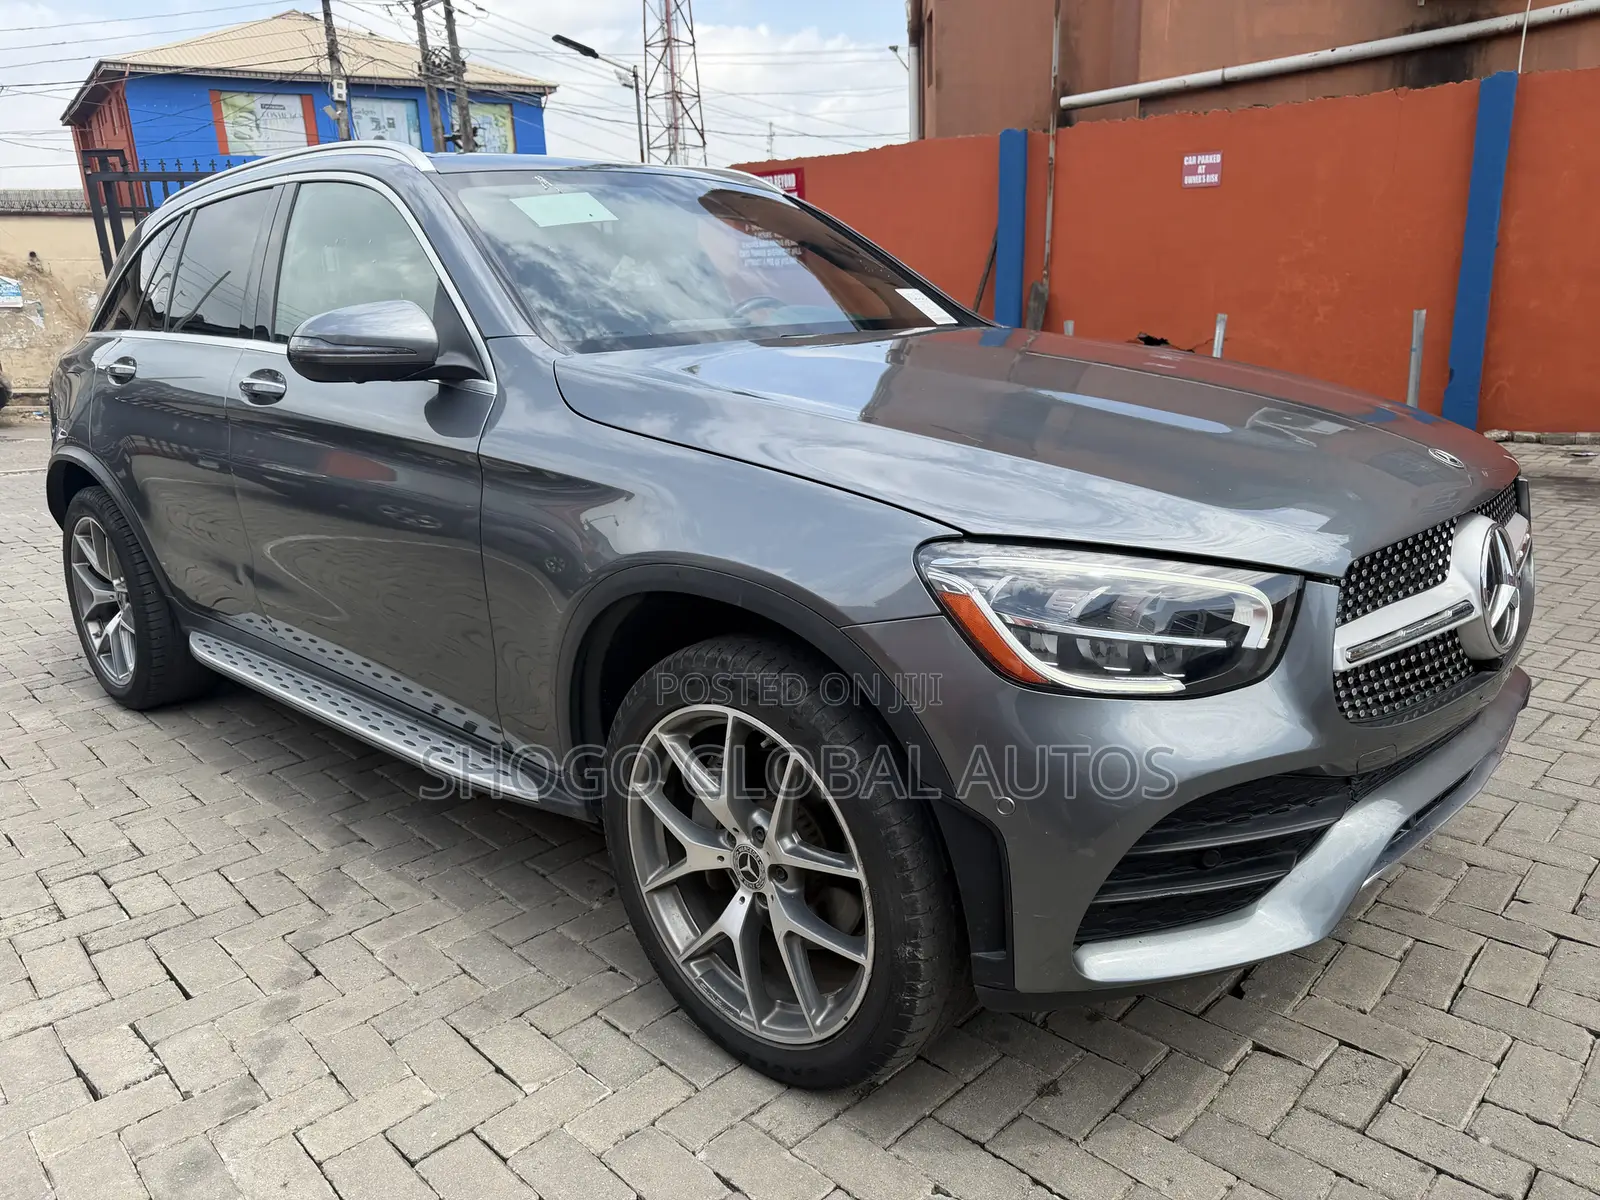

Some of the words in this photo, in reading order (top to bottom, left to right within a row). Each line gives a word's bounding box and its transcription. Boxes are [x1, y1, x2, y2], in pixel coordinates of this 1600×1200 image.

[1184, 156, 1197, 165] CAR
[1197, 154, 1221, 165] PARKED
[1197, 165, 1206, 174] AT
